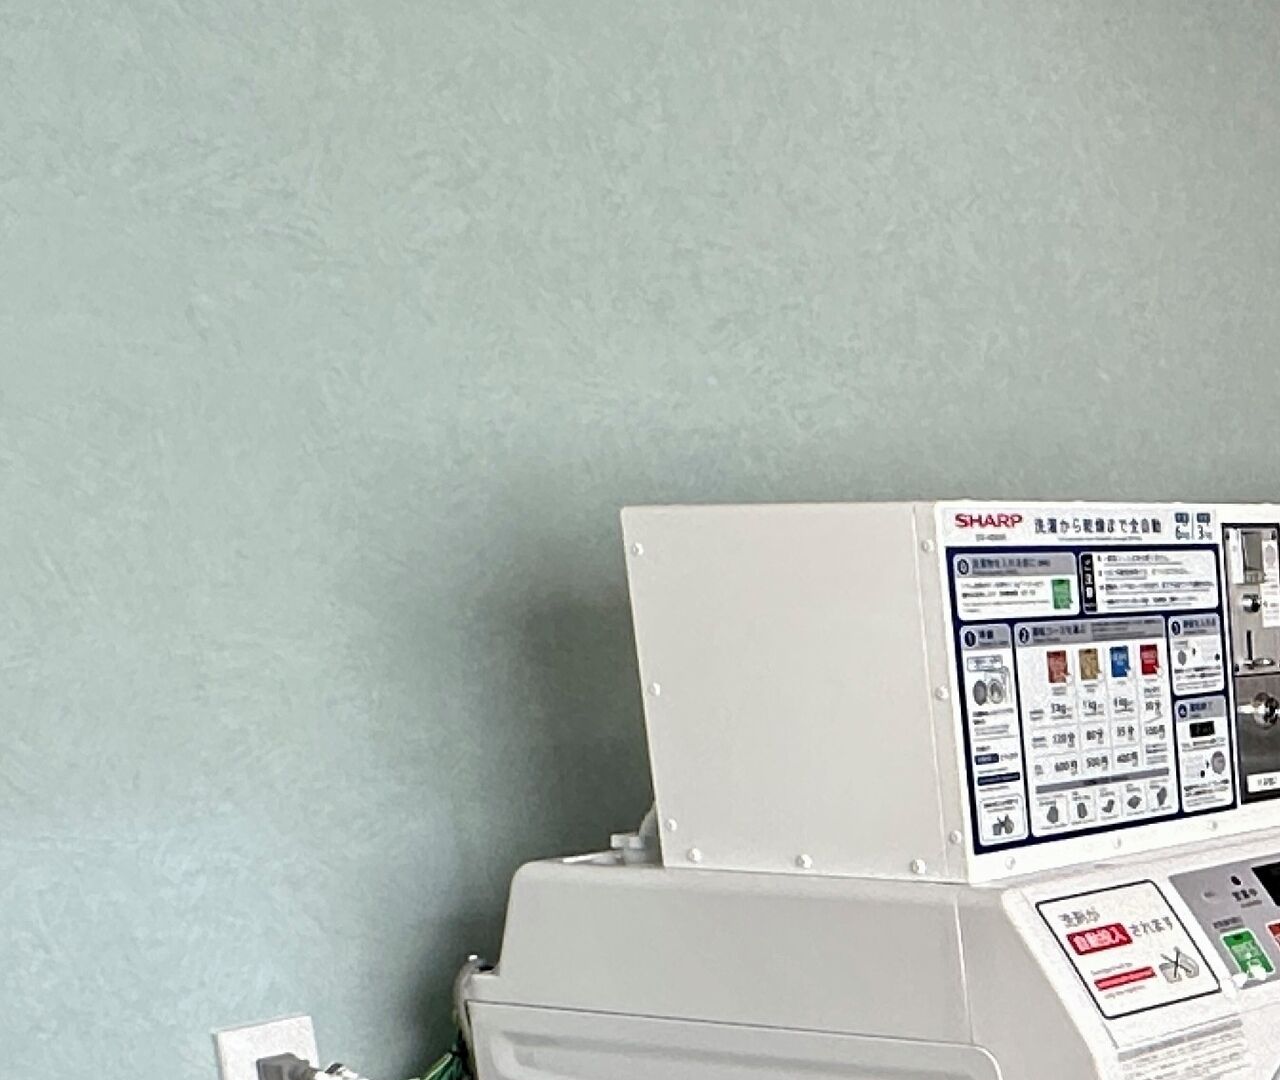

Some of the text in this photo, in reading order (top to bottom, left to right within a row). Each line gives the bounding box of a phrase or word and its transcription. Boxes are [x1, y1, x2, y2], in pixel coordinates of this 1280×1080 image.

[954, 513, 1023, 528] SHARP
[1034, 517, 1162, 535] 洗濯から乾燥まで全自動
